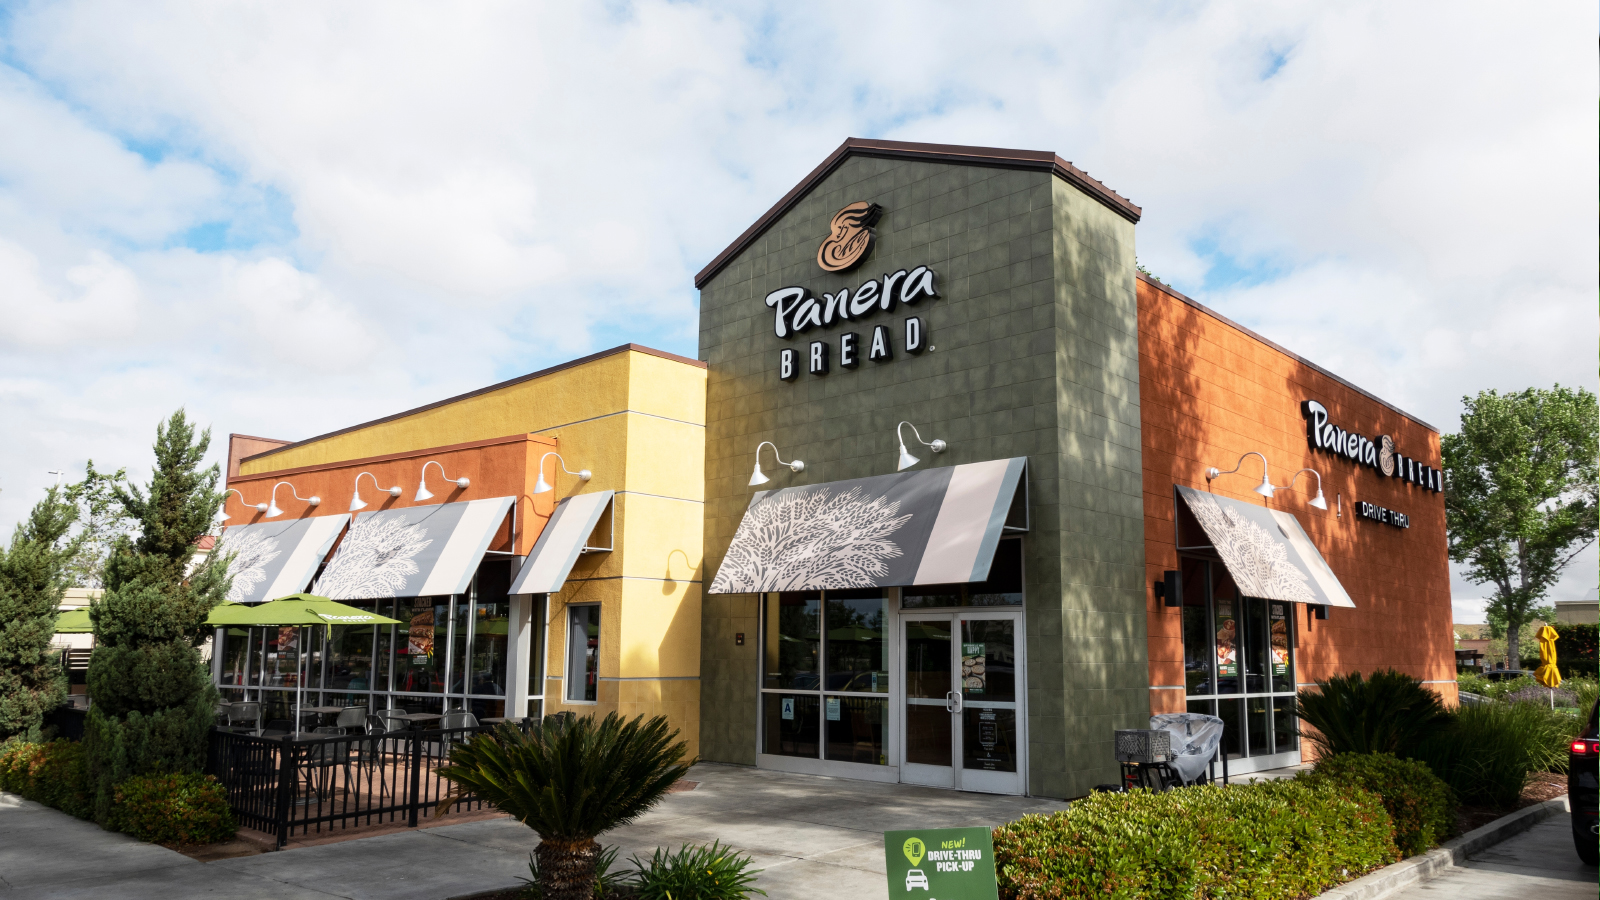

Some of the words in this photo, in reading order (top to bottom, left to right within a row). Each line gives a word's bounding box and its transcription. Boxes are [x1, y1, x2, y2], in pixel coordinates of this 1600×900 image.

[765, 265, 936, 338] Panera
[780, 316, 925, 381] BREAD
[1306, 400, 1378, 467] Panera
[1396, 452, 1443, 492] BREAD
[1362, 501, 1388, 522] DRIVE
[1389, 510, 1410, 529] THRU
[784, 703, 792, 713] A
[941, 837, 966, 849] NEW!
[927, 849, 982, 861] DRIVE-THRU
[936, 861, 975, 872] PICK-UP
